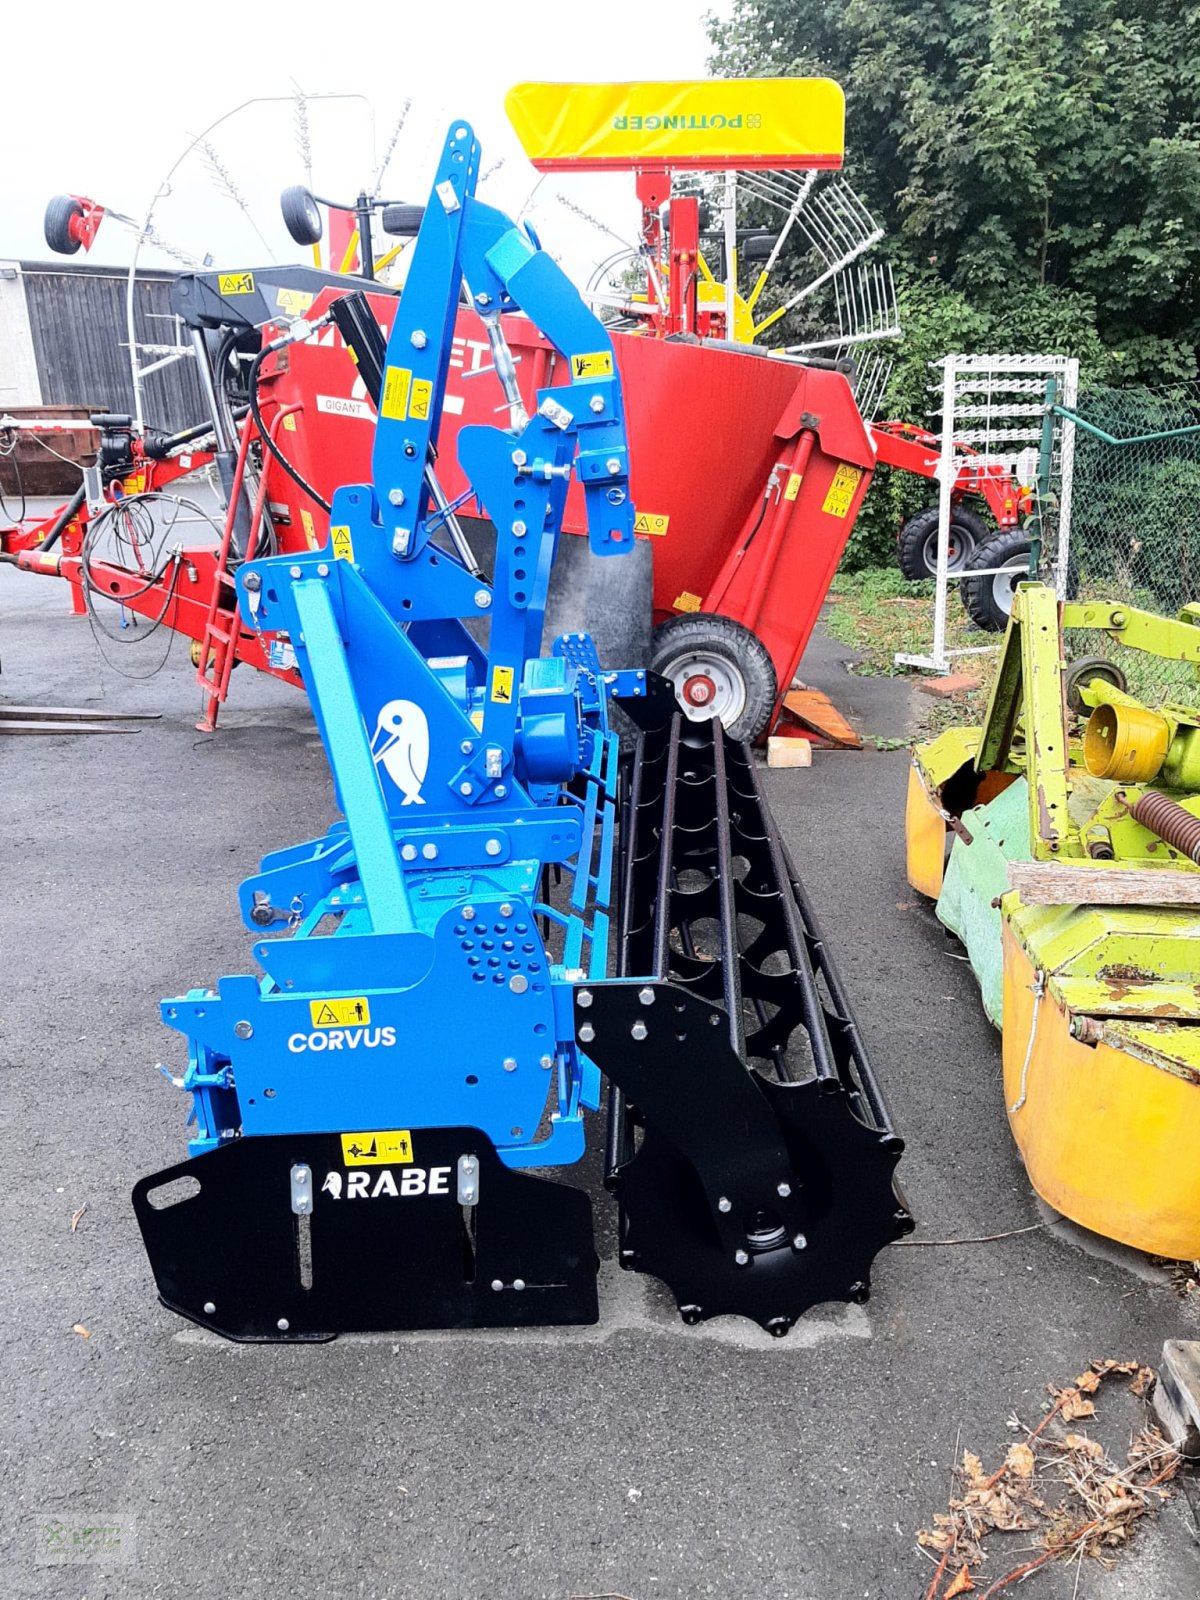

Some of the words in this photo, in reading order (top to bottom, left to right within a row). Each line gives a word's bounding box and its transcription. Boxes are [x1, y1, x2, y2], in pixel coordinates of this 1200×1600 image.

[325, 399, 362, 415] GIGANT
[288, 1026, 397, 1053] CORVUS
[347, 1166, 452, 1199] RABE
